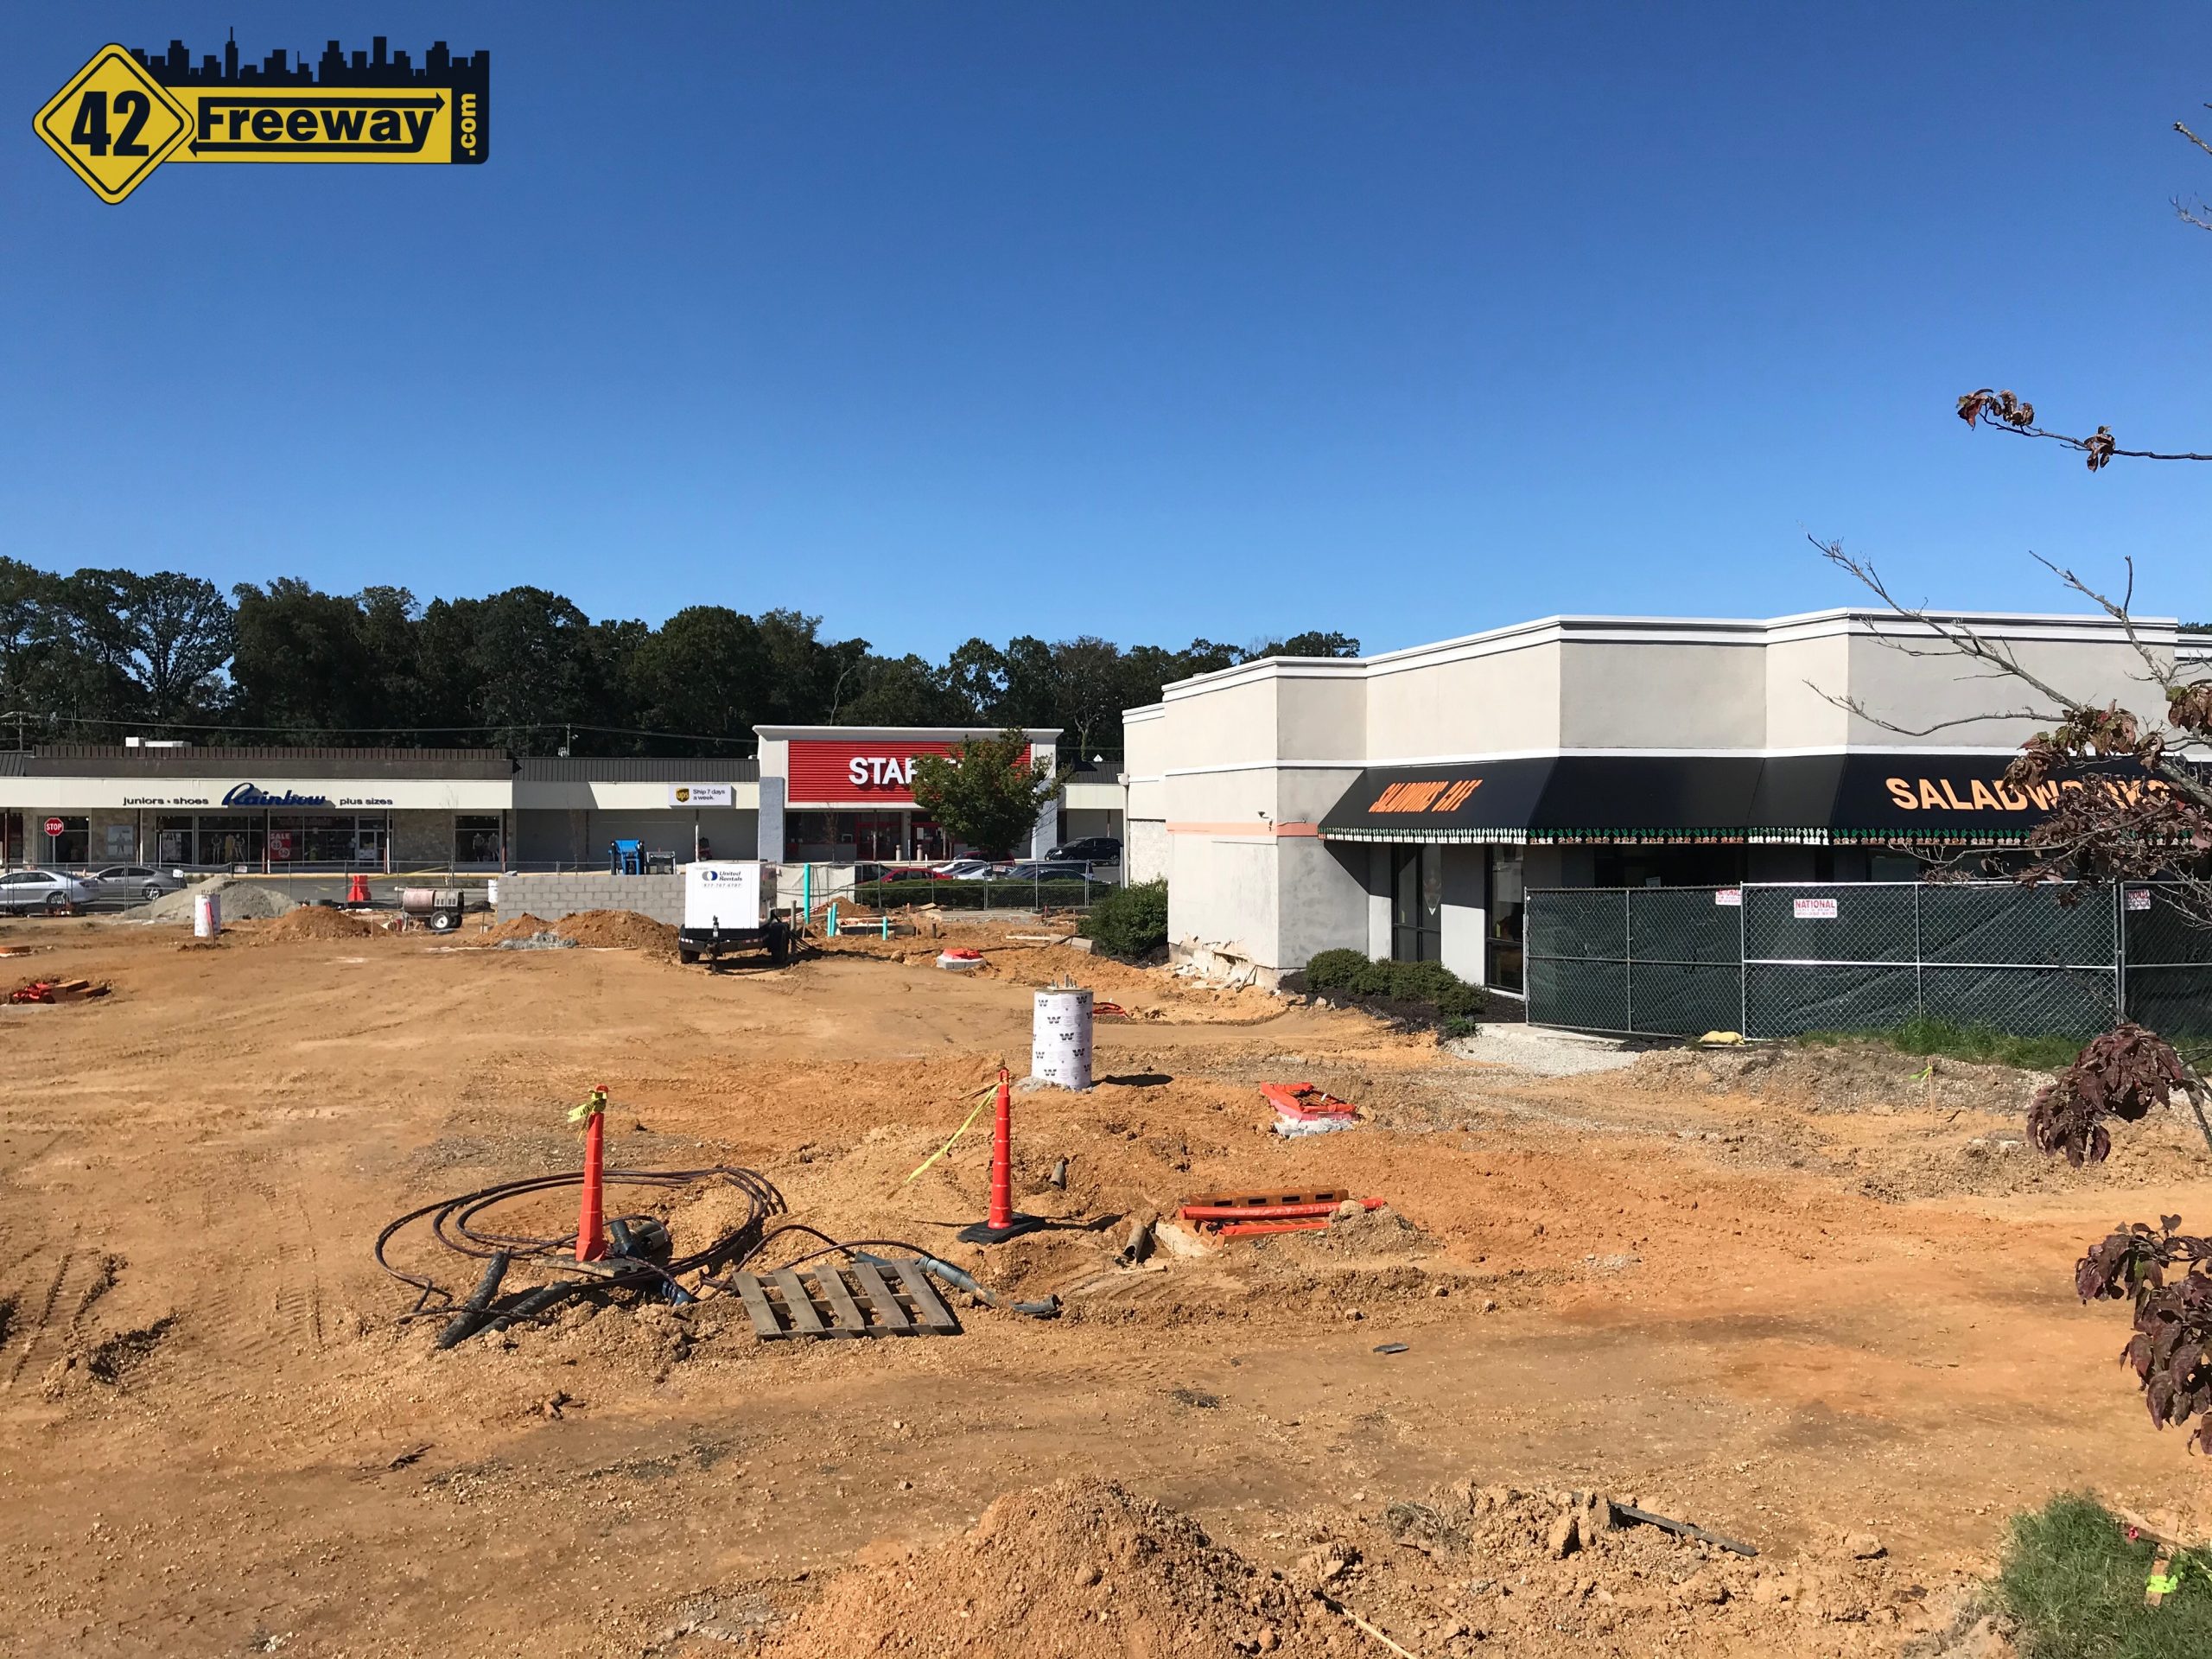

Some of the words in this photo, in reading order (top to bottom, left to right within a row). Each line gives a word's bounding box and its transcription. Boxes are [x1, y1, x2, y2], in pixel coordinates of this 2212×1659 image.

[221, 782, 327, 806] Rainbow
[677, 791, 689, 801] ups
[1885, 778, 2171, 811] SALADWKS
[123, 797, 164, 806] juniors
[174, 797, 209, 805] shoes
[340, 798, 363, 806] plus
[46, 823, 62, 831] STOP
[1795, 899, 1836, 909] NATIONAL
